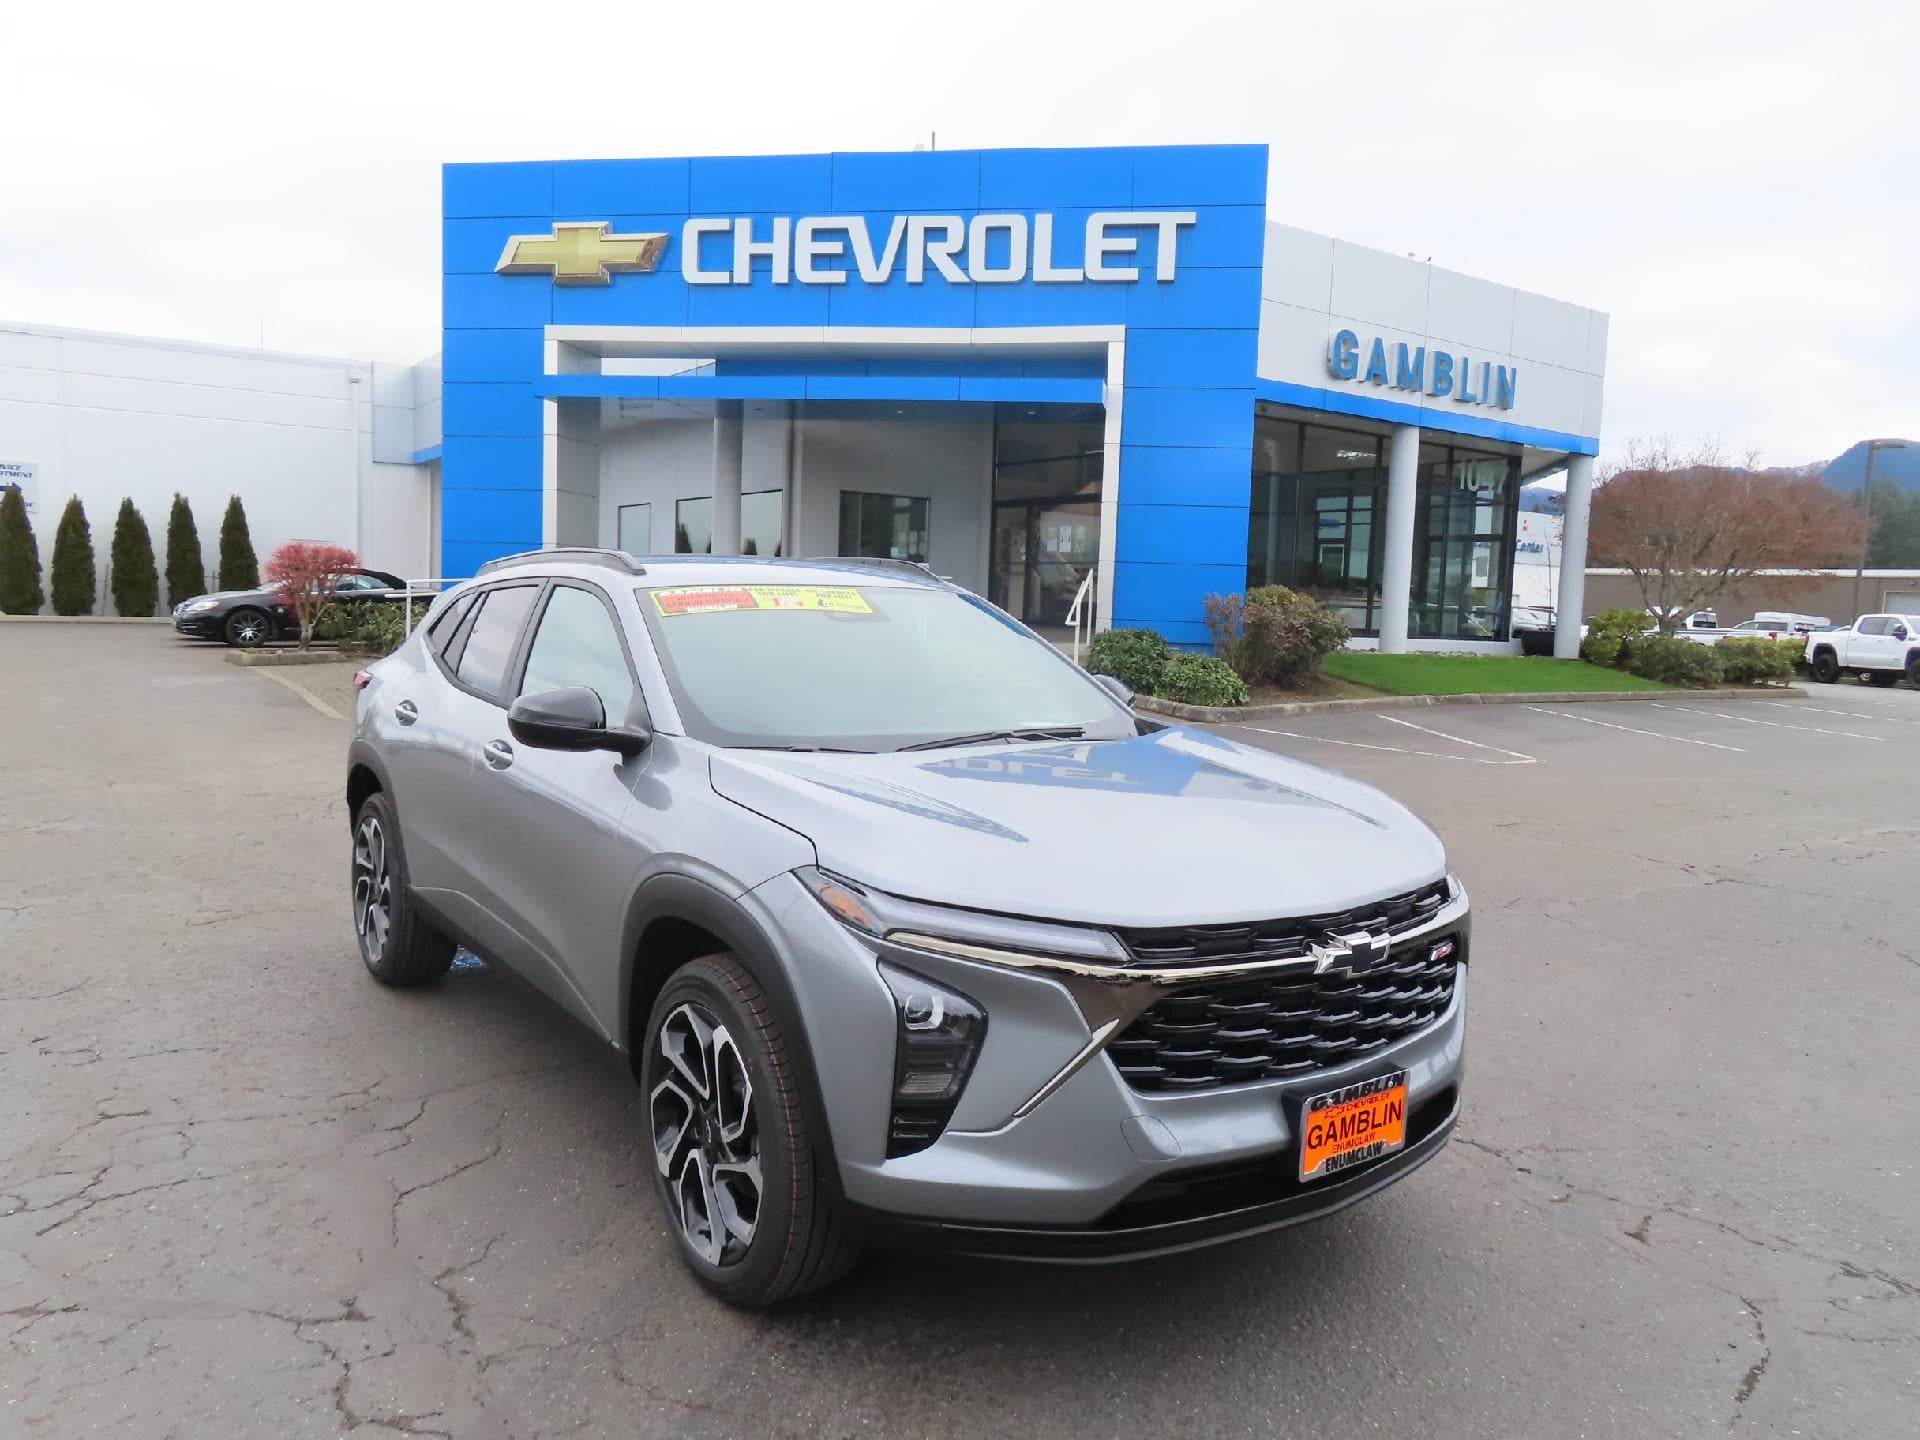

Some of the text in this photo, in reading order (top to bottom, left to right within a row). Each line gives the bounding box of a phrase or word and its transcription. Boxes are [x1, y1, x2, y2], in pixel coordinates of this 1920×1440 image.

[681, 210, 1197, 285] CHEVROLET
[1330, 328, 1518, 411] GAMBLIN
[1310, 1072, 1405, 1112] GAMBLIN
[1346, 1092, 1391, 1112] CHEVROLET
[1307, 1099, 1402, 1150] GAMBLIN
[1332, 1131, 1377, 1154] ENUMCLAW
[1325, 1141, 1382, 1173] ENUMCLAW
